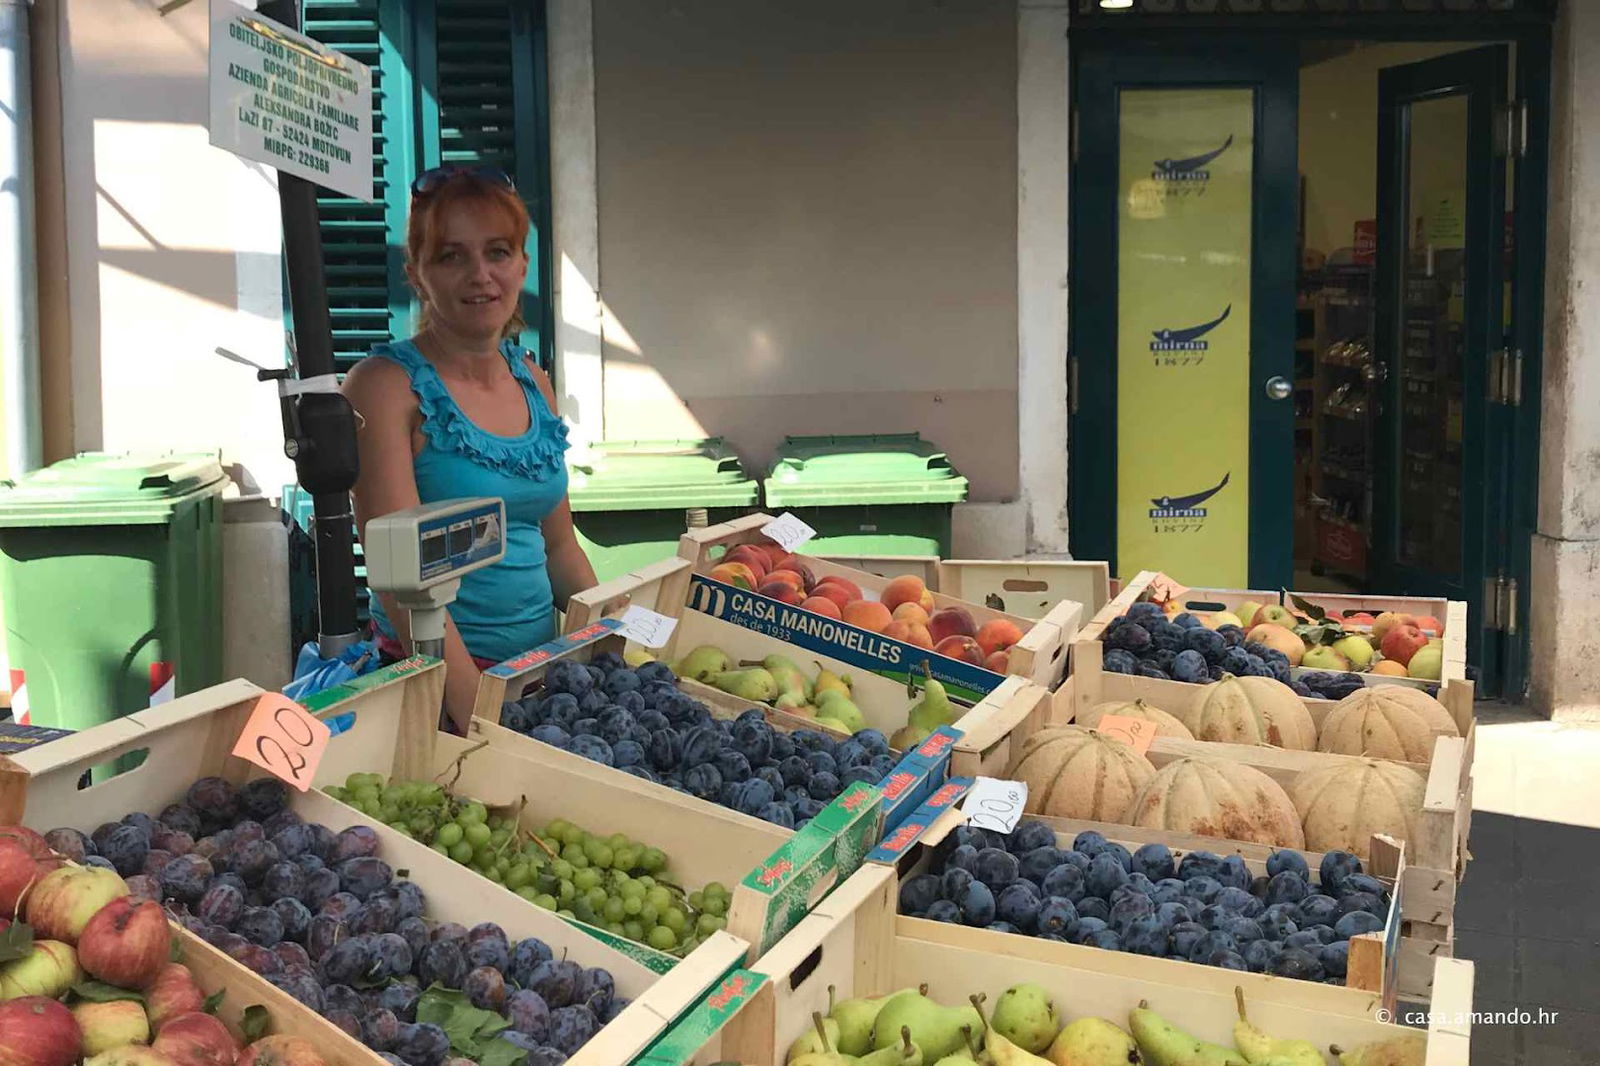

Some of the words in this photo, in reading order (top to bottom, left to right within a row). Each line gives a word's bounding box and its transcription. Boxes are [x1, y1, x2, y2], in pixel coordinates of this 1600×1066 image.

[229, 22, 284, 60] OBITELJSKO
[229, 62, 268, 92] AZIENDA
[271, 81, 315, 112] AGRICOLA
[317, 101, 359, 132] FAMILIARE
[263, 58, 330, 100] GOSPODARSTVO
[254, 94, 312, 130] ALEKSANDRA
[312, 137, 352, 165] MOTOVUN
[1151, 507, 1205, 517] mirna
[729, 613, 749, 627] des
[750, 619, 764, 631] de
[766, 624, 792, 641] 1933
[731, 593, 776, 623] CASA
[781, 608, 902, 664] MANONELLES
[256, 707, 314, 780] 20
